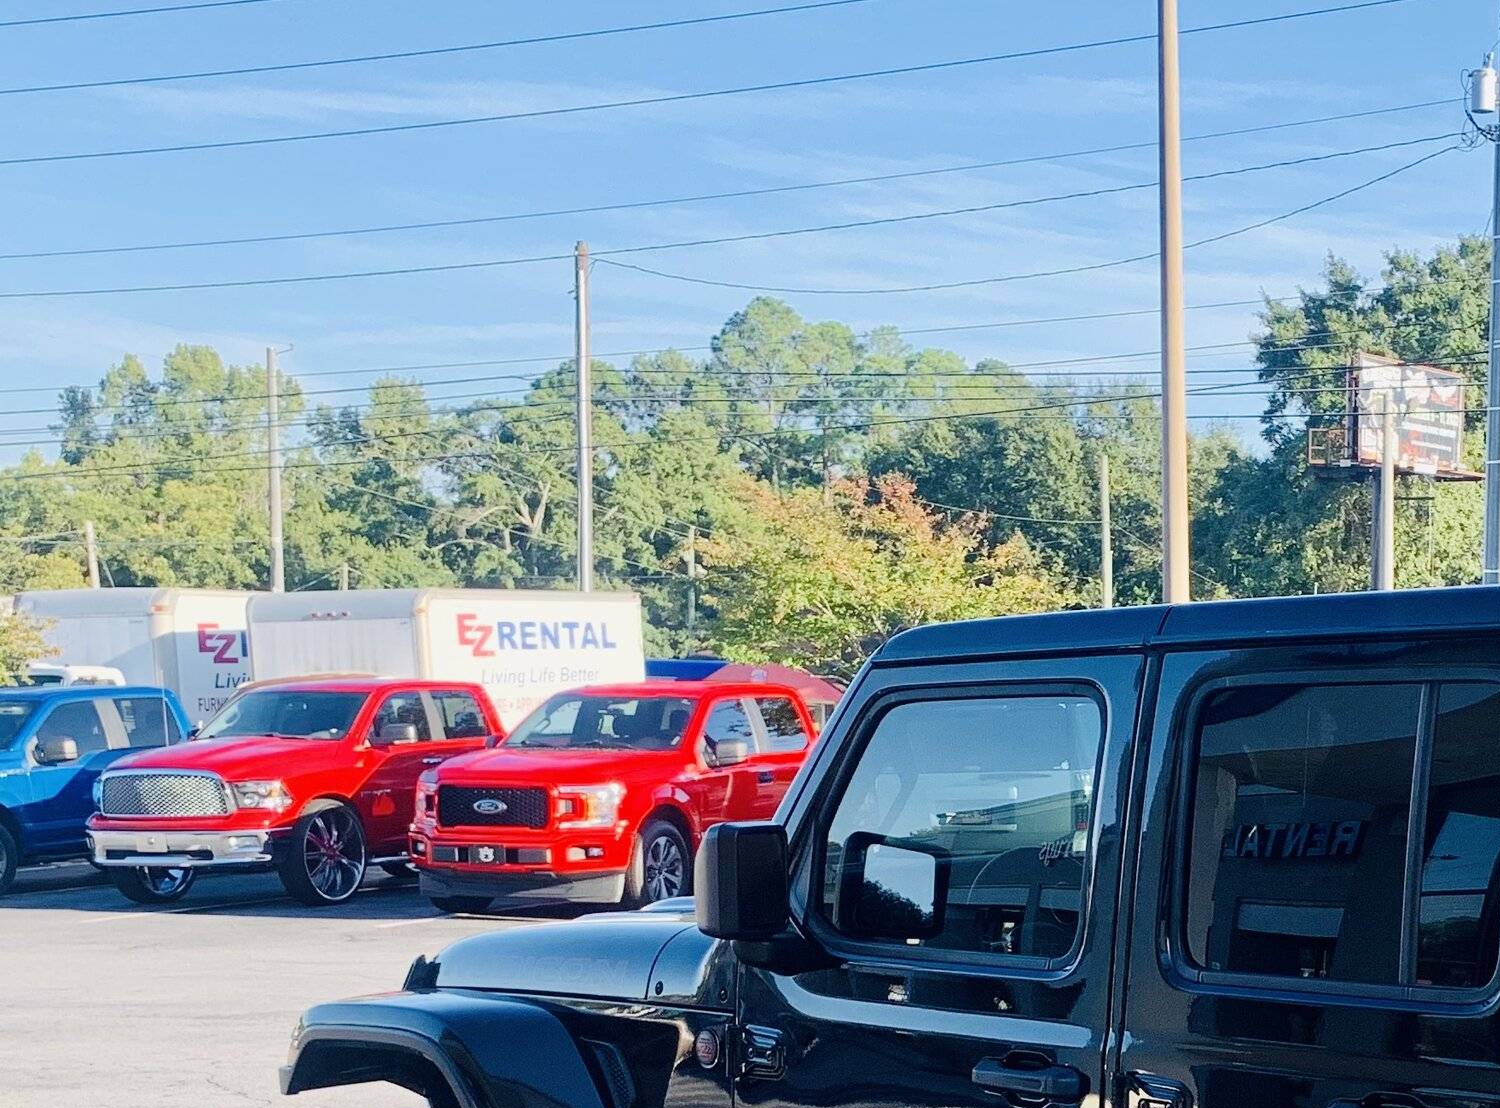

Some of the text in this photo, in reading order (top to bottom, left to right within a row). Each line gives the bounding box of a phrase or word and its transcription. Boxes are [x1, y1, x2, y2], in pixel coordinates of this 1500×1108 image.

[197, 622, 240, 664] EZ
[456, 612, 617, 658] EZ RENTAL
[481, 666, 600, 687] Living Life Better
